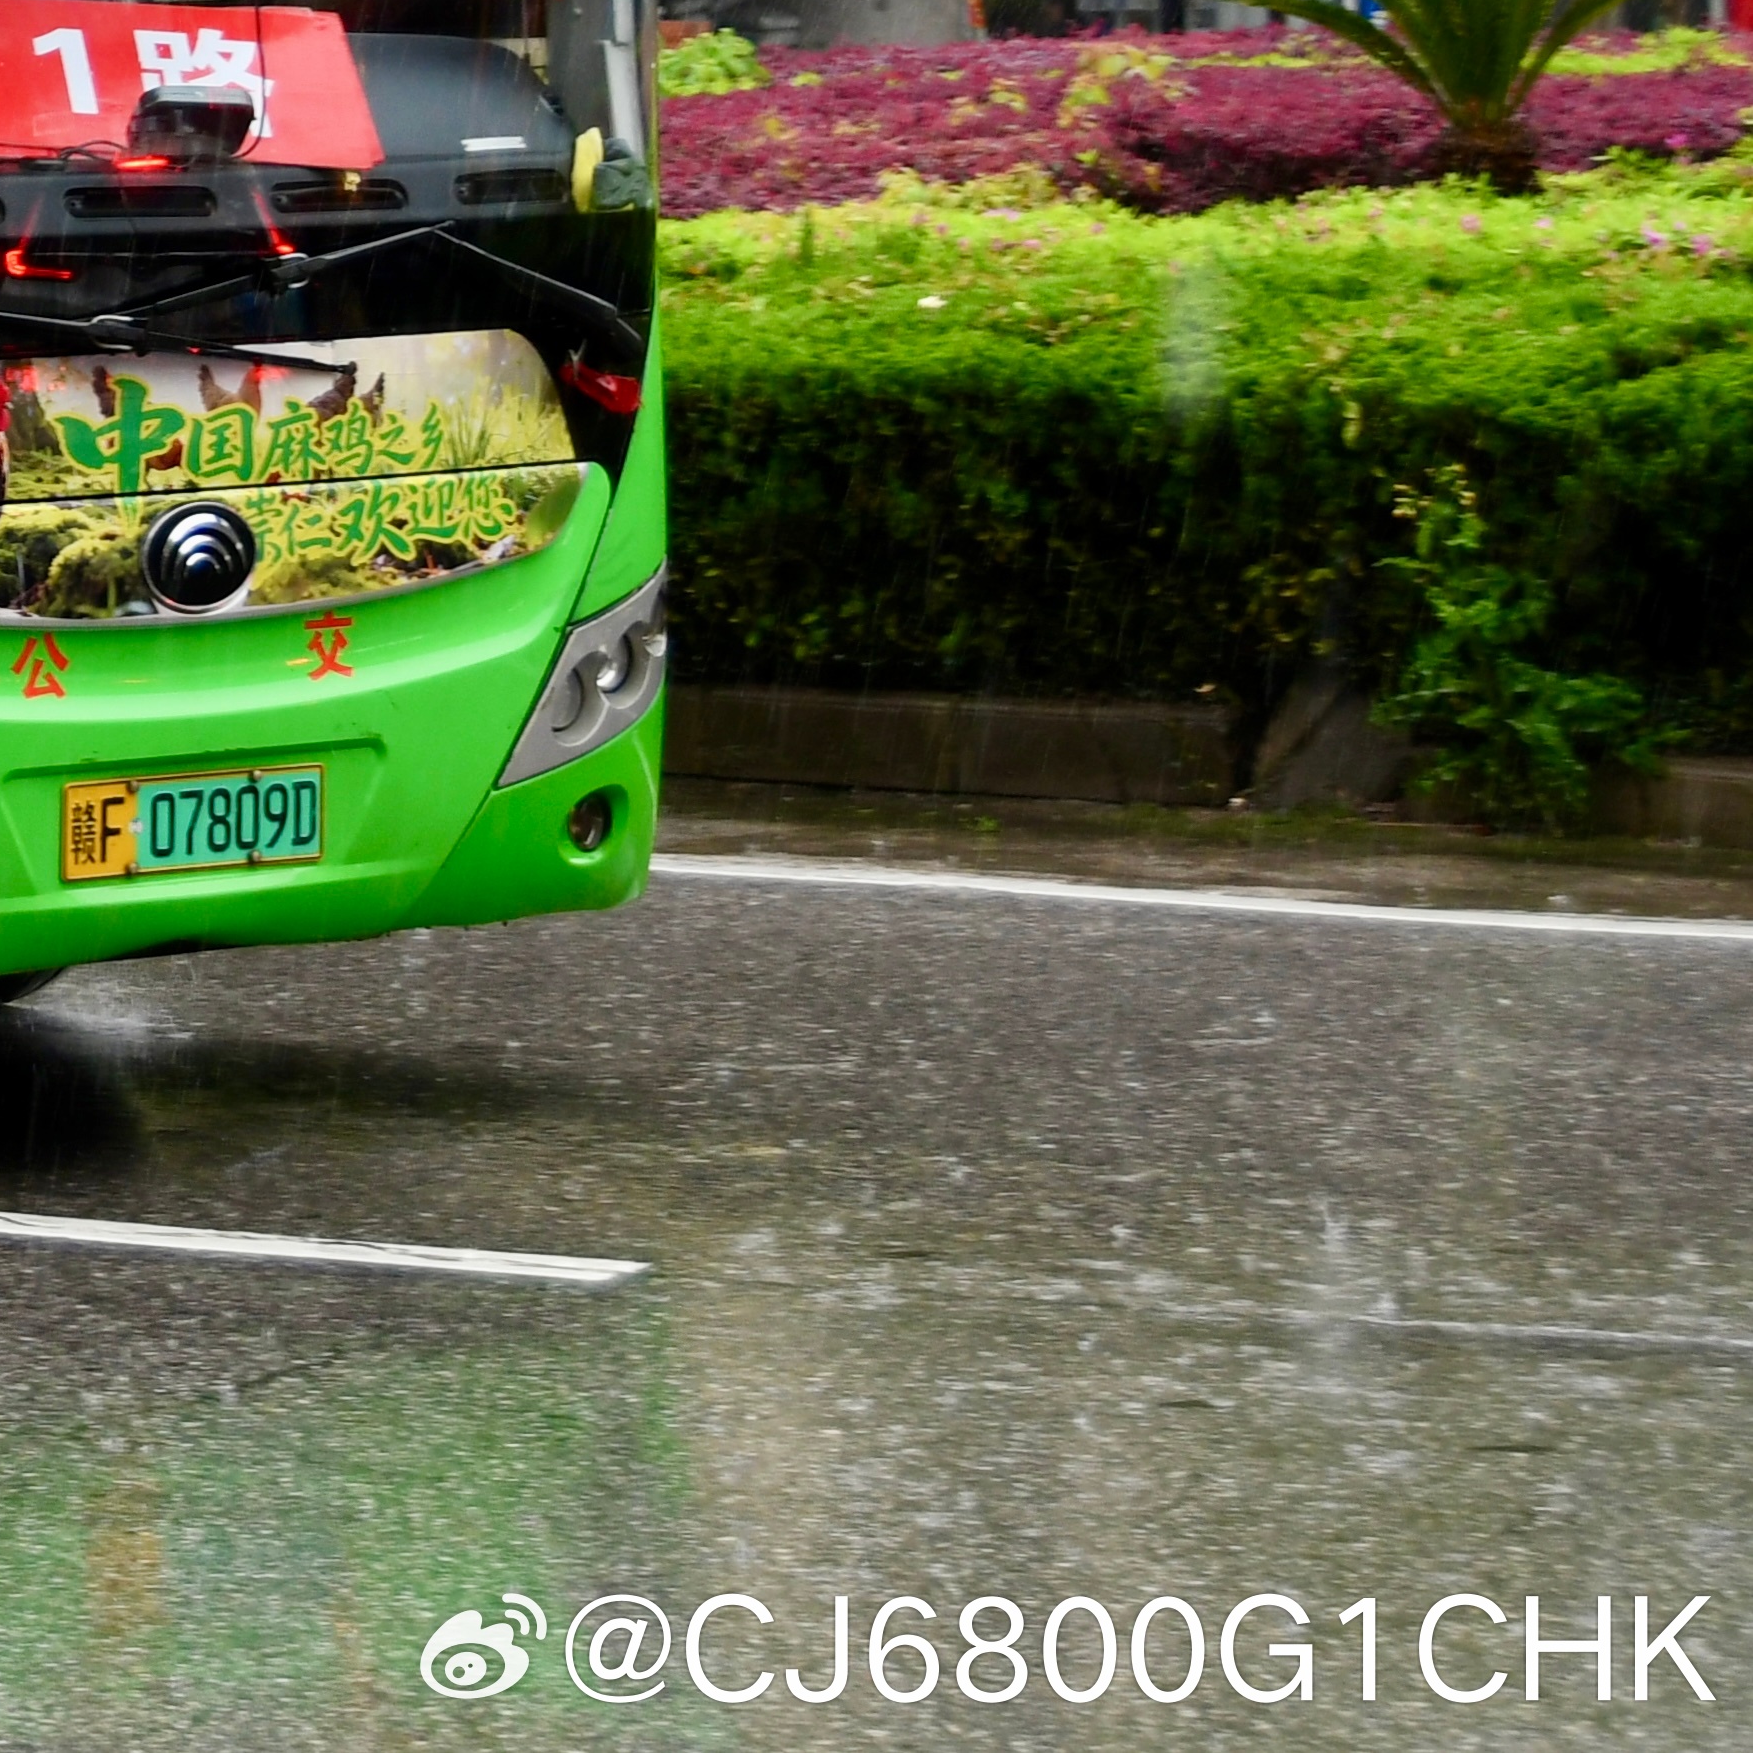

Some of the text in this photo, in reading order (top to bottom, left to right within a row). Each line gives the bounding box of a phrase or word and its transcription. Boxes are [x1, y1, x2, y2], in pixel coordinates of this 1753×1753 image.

[55, 377, 445, 524] 中国麻鸡之乡
[11, 610, 355, 699] 公 交
